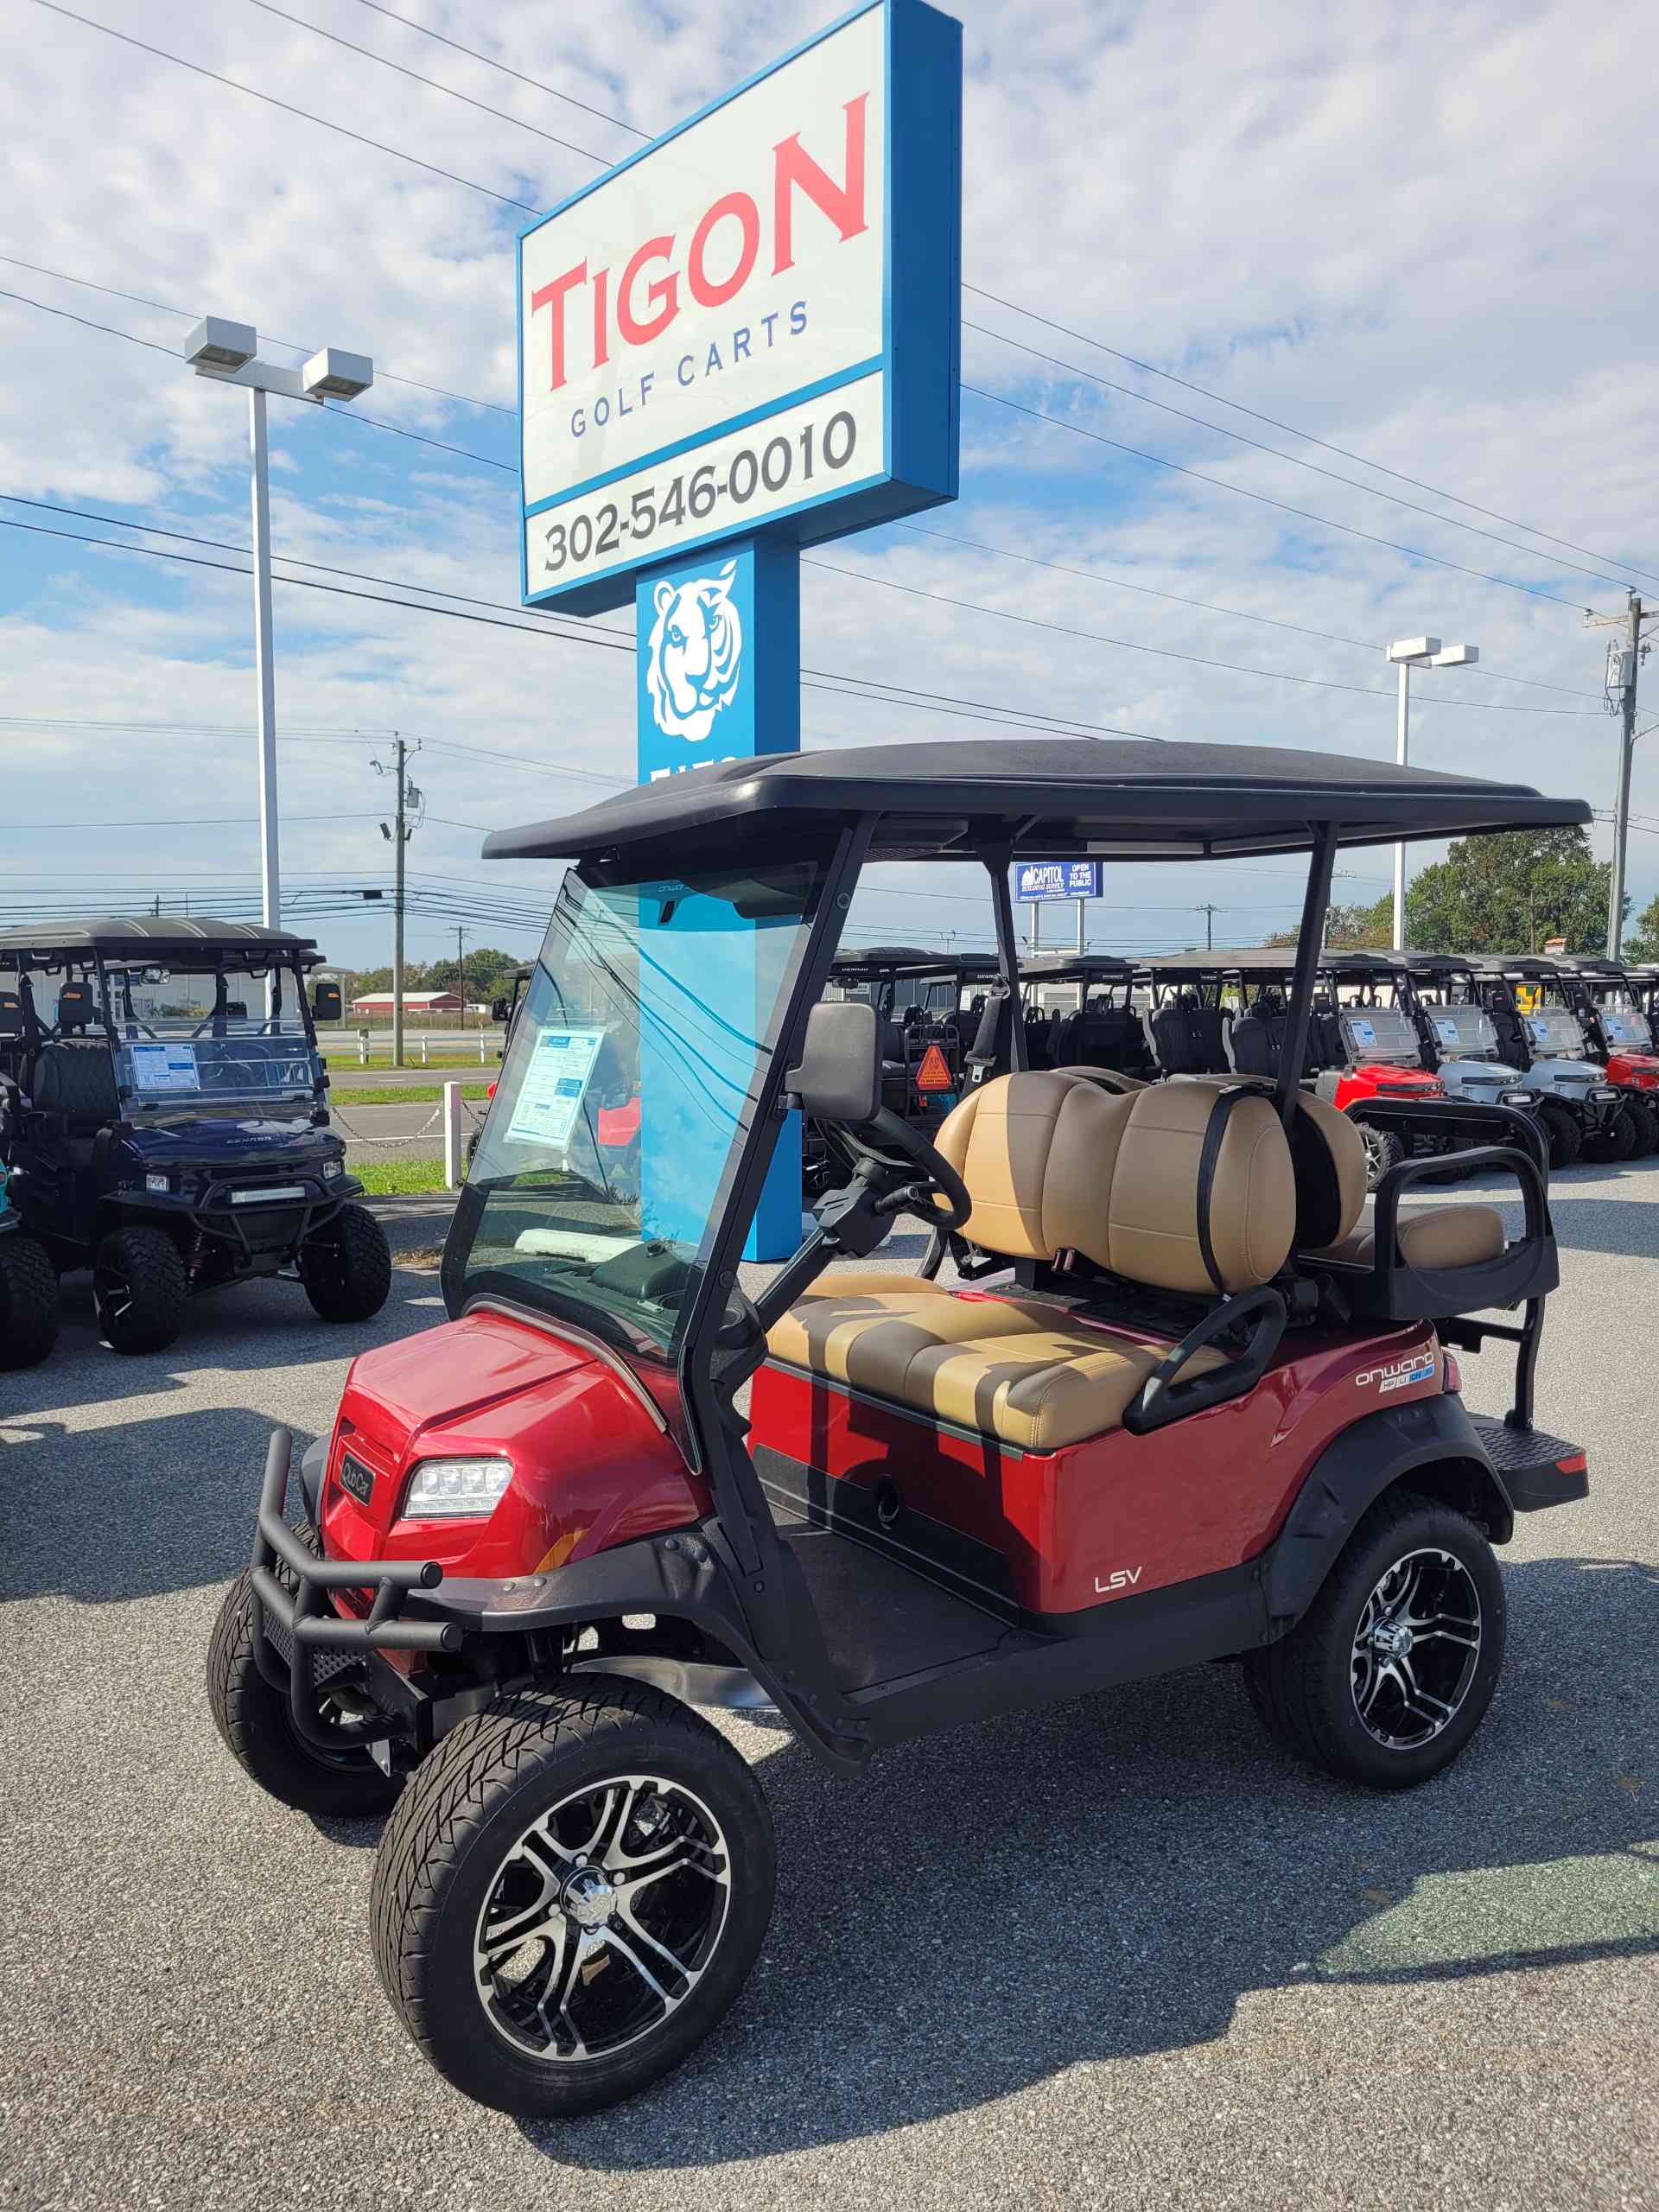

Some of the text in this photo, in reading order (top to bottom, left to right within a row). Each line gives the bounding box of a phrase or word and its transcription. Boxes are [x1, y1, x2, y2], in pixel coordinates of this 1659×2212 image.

[531, 91, 870, 392] TIGON
[570, 301, 808, 438] GOLF CARTS
[544, 410, 856, 572] 302-546-0010
[1033, 866, 1064, 884] CAPITOL
[1095, 1566, 1142, 1593] LSV
